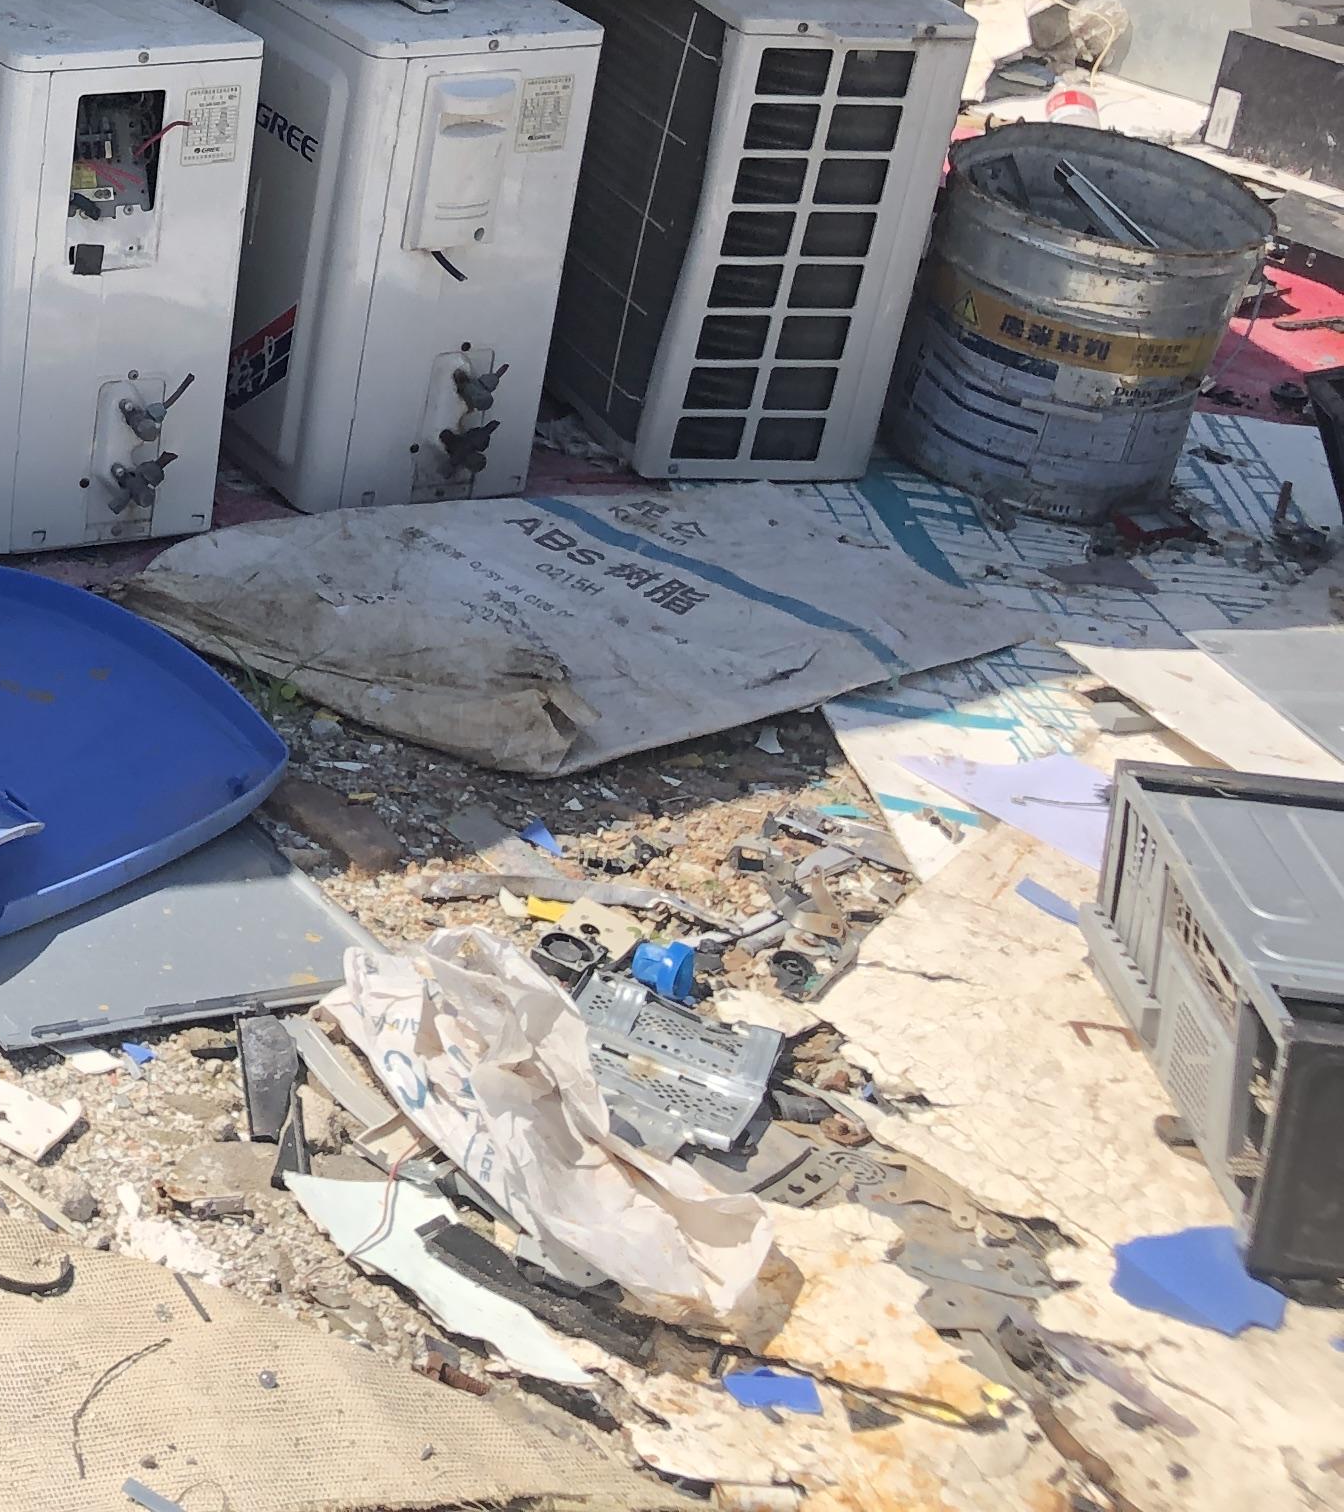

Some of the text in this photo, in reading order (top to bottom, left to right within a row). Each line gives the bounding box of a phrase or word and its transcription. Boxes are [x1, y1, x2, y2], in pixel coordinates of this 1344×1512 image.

[257, 102, 319, 163] GREE
[504, 516, 606, 566] ABS
[603, 561, 710, 615] 树脂
[479, 1138, 496, 1183] ADE
